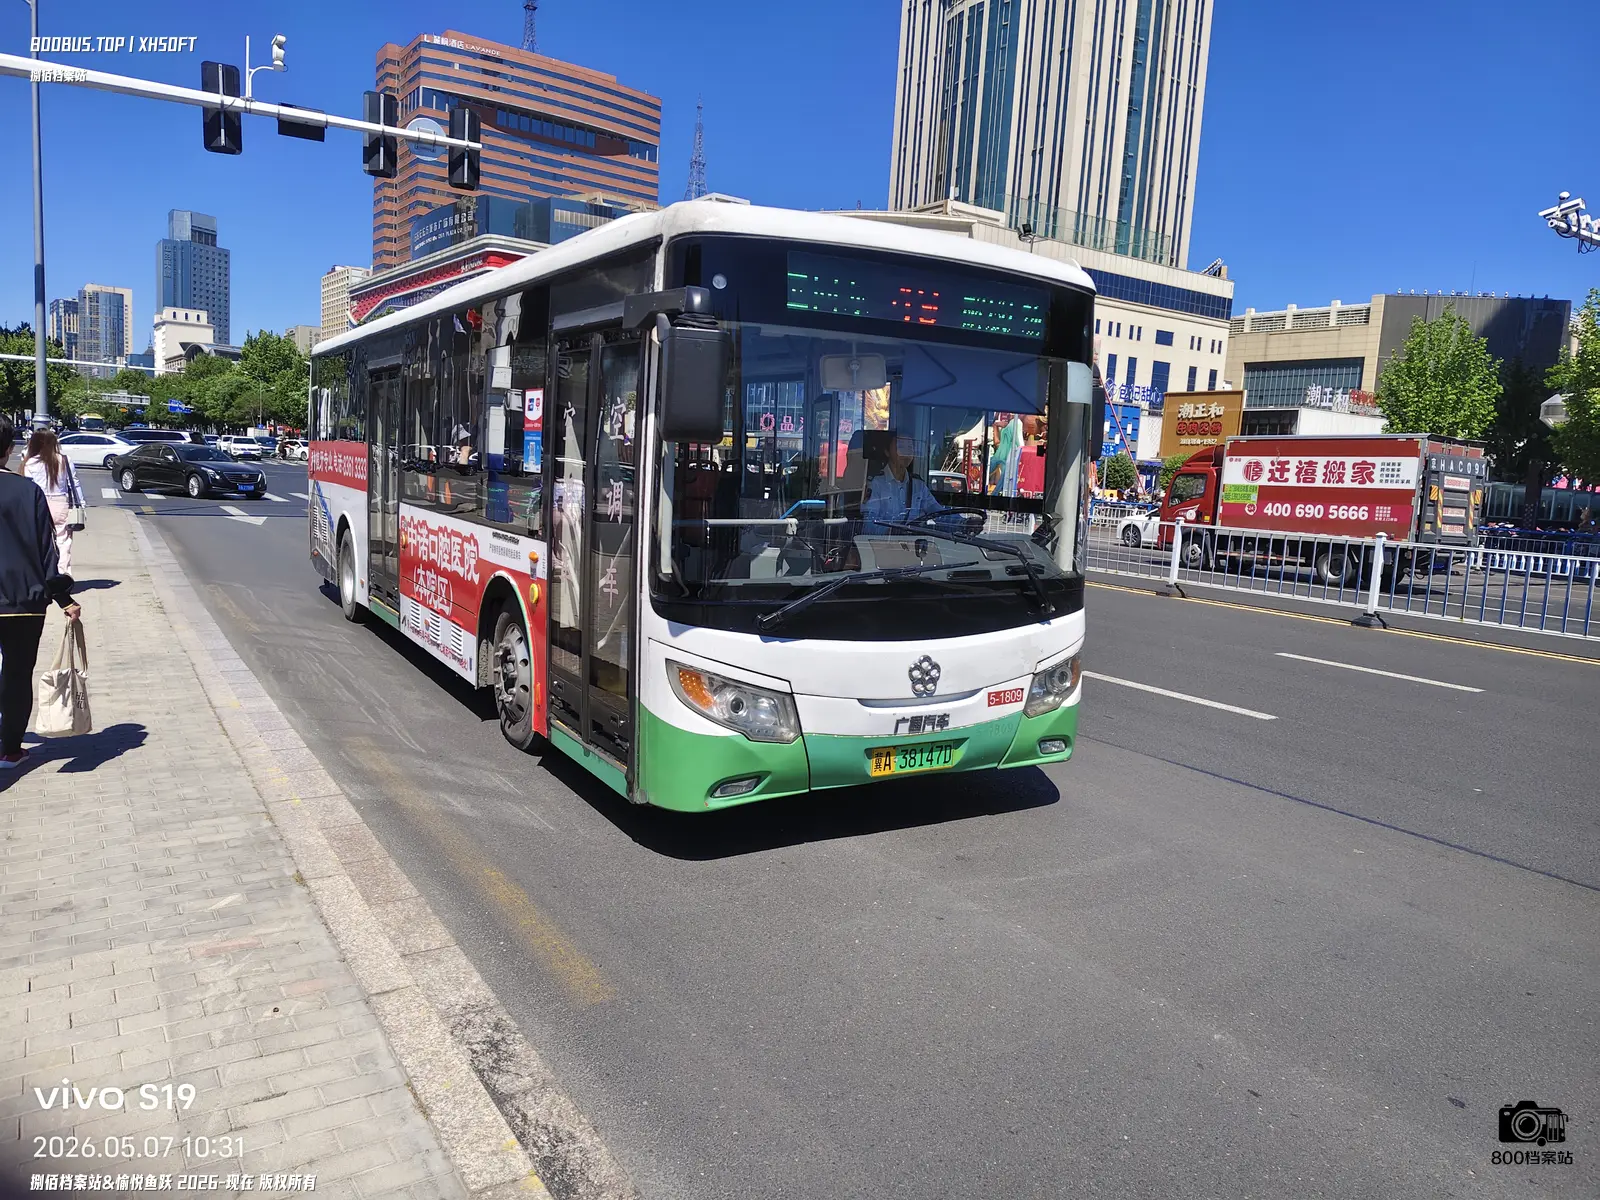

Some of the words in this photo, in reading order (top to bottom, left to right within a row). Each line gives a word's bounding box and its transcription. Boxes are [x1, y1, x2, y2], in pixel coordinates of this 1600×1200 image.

[1306, 383, 1350, 413] 潮正和
[1178, 402, 1225, 419] 潮正和
[1176, 421, 1222, 435] 牛肉火锅
[1267, 459, 1376, 485] 迁禧搬家
[603, 396, 627, 608] 空调车
[1263, 502, 1291, 517] 400
[1295, 504, 1324, 519] 690
[1328, 505, 1369, 520] 5666
[407, 521, 480, 585] 中诺口腔医院
[989, 690, 1022, 705] 5-1809
